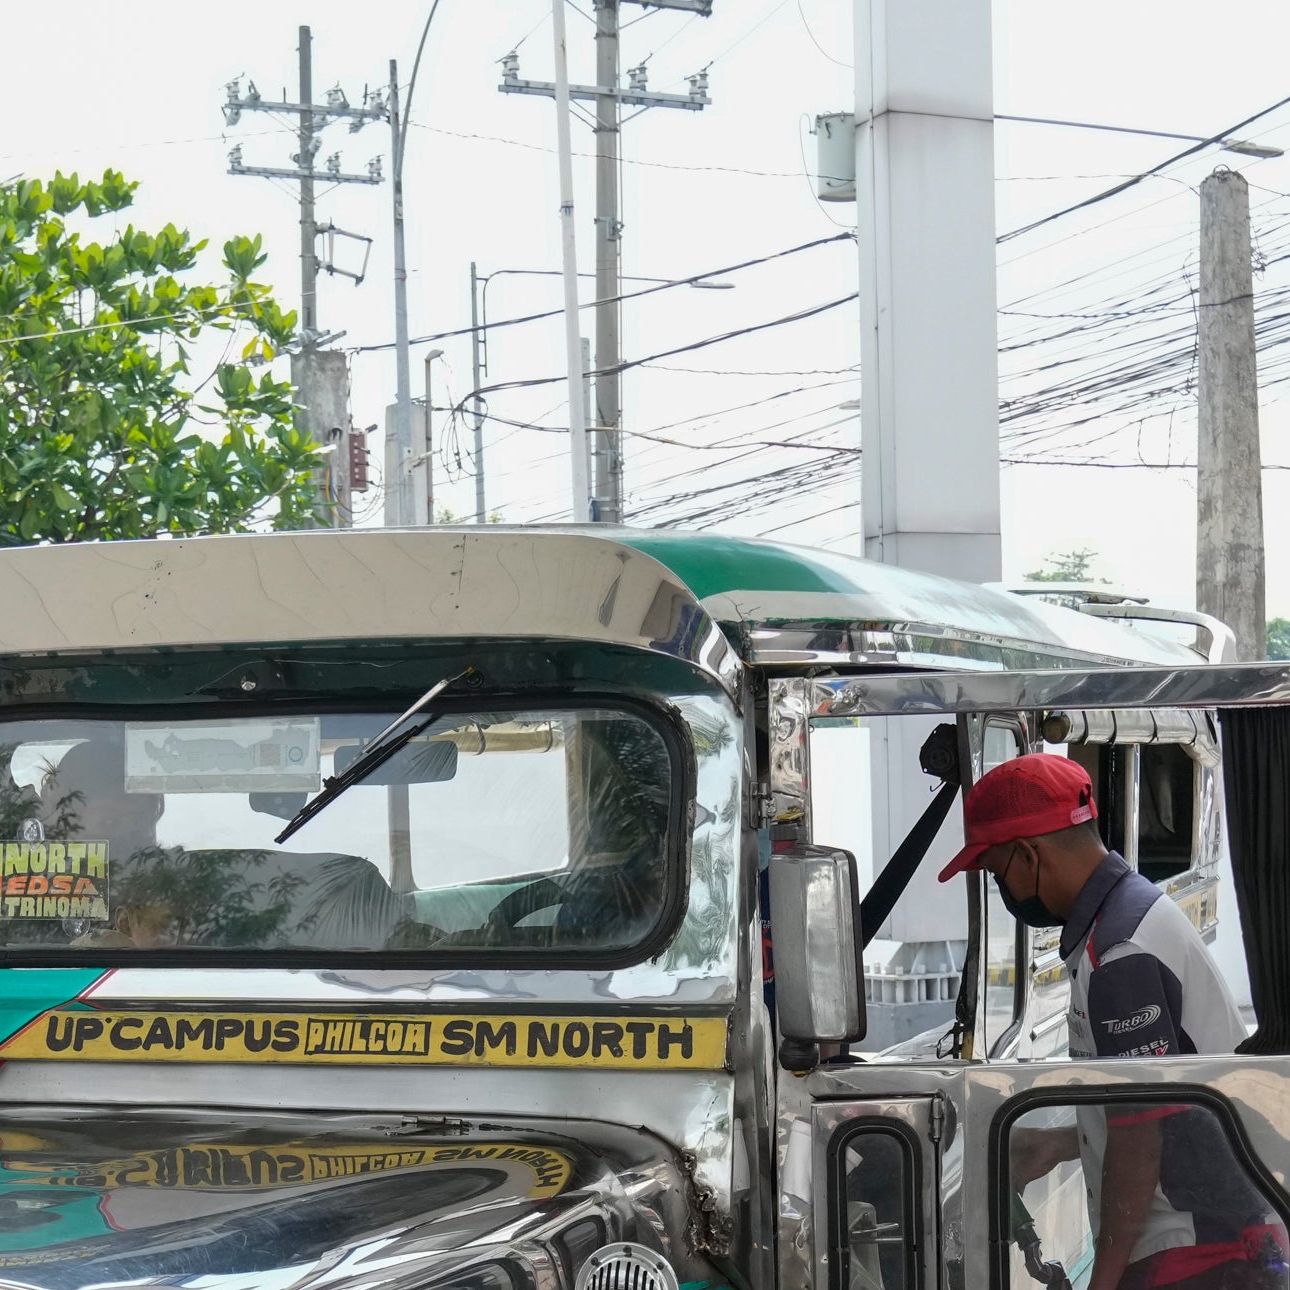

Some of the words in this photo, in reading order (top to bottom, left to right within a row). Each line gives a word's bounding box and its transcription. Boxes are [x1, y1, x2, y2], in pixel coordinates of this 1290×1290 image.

[5, 843, 106, 878] NORTH
[5, 875, 99, 895] EDSA
[4, 896, 108, 920] TRINOMA
[1101, 1011, 1150, 1033] TURBO
[45, 1015, 105, 1051] UP
[109, 1016, 300, 1052] CAMPUS
[440, 1020, 516, 1057] SM
[526, 1021, 694, 1060] NORTH
[1118, 1036, 1169, 1058] DIESEL
